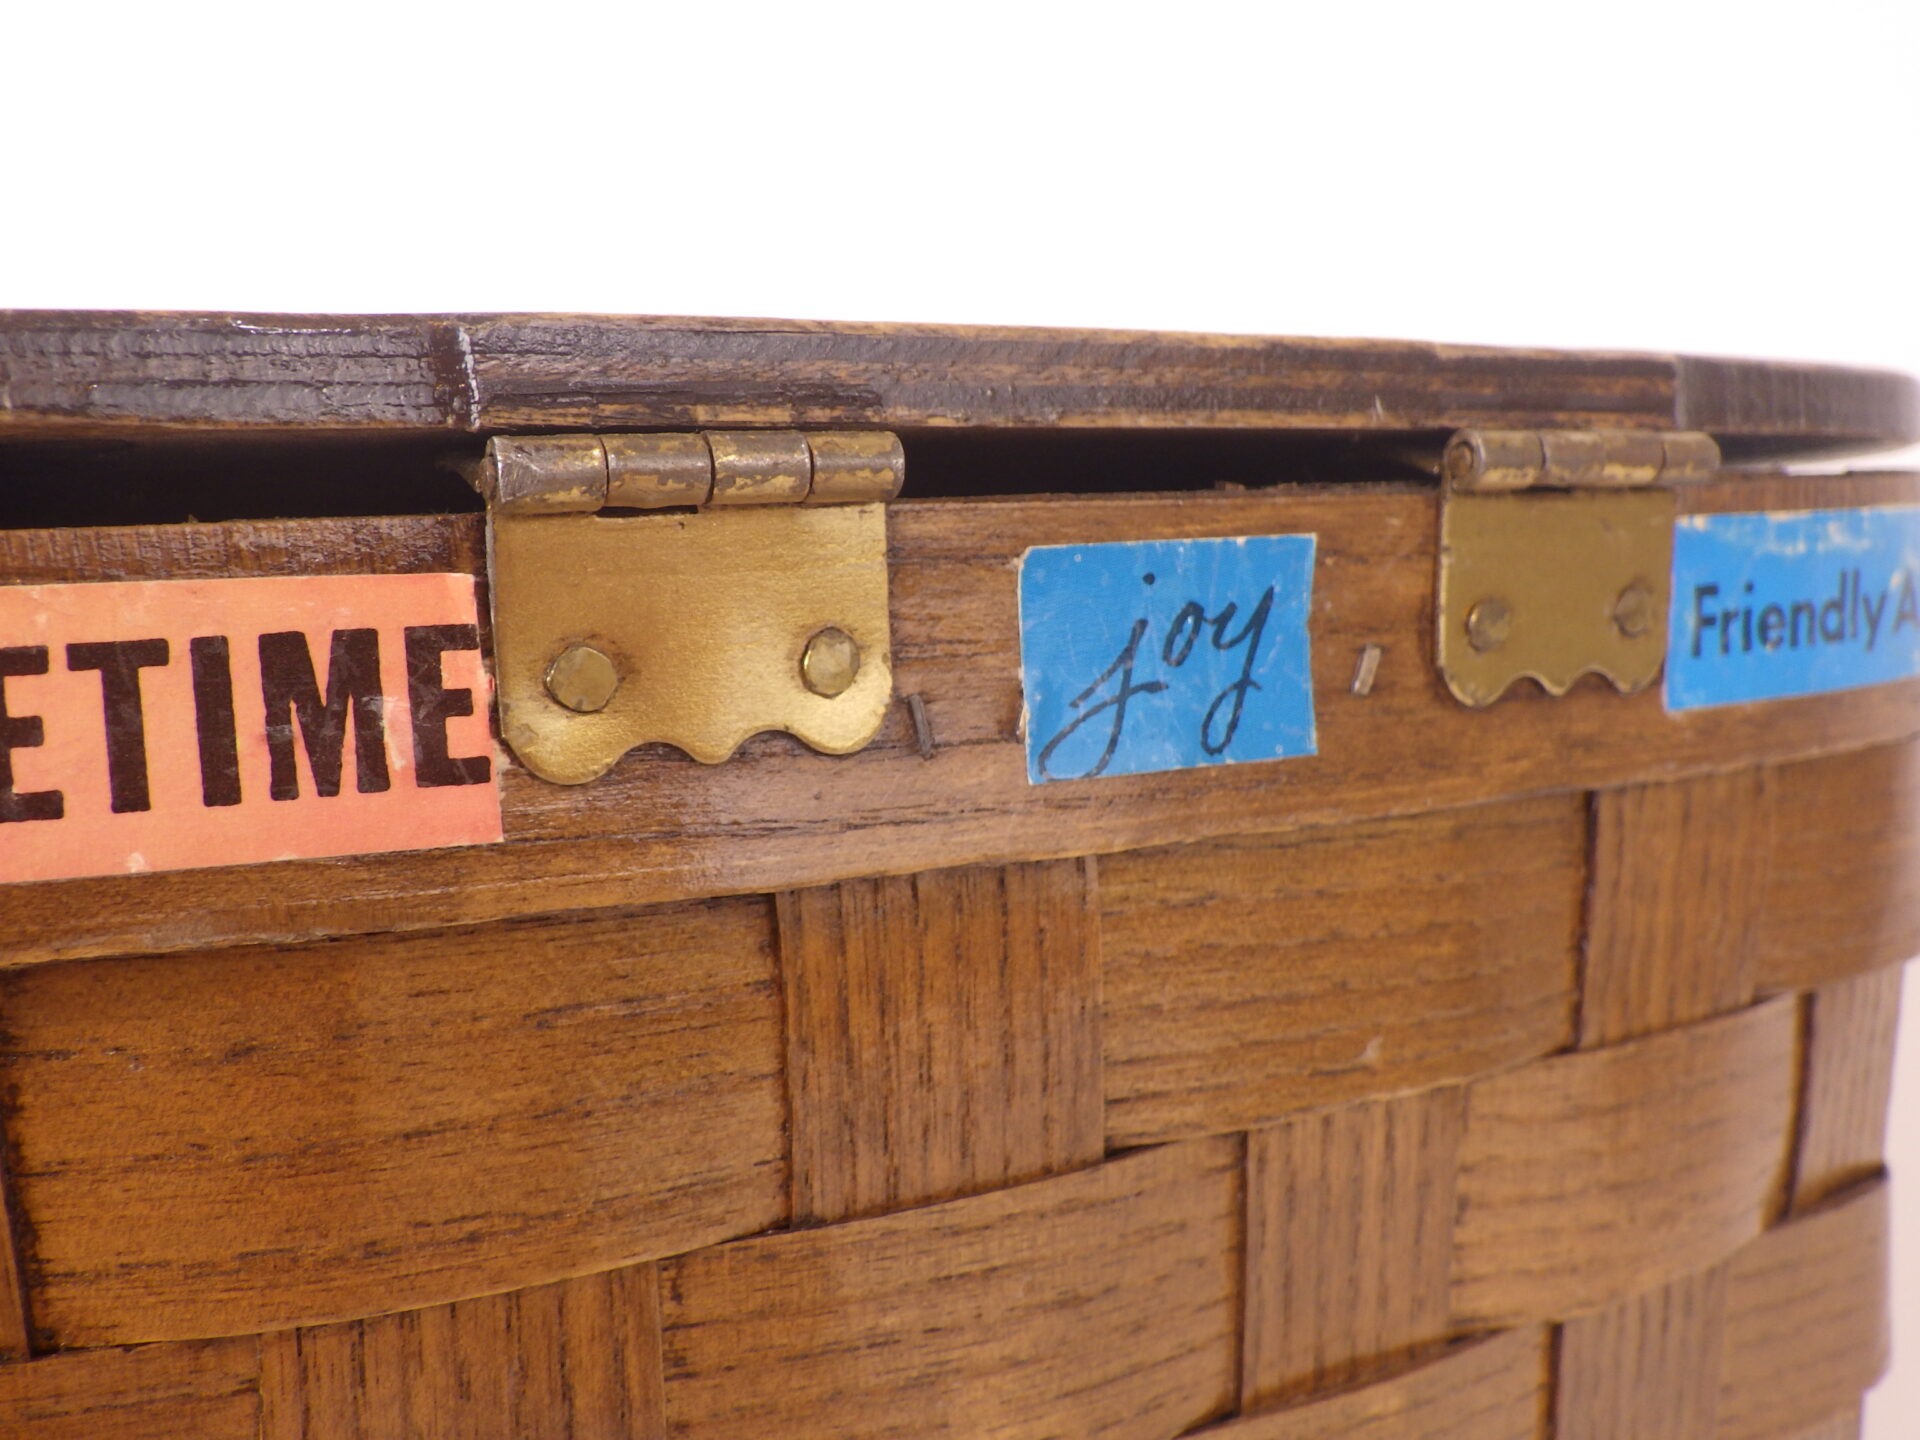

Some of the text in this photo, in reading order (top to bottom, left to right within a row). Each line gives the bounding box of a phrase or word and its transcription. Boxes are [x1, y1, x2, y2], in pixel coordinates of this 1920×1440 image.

[1038, 572, 1275, 782] joy
[1691, 568, 1888, 658] Friendly
[0, 624, 492, 823] ETIME
